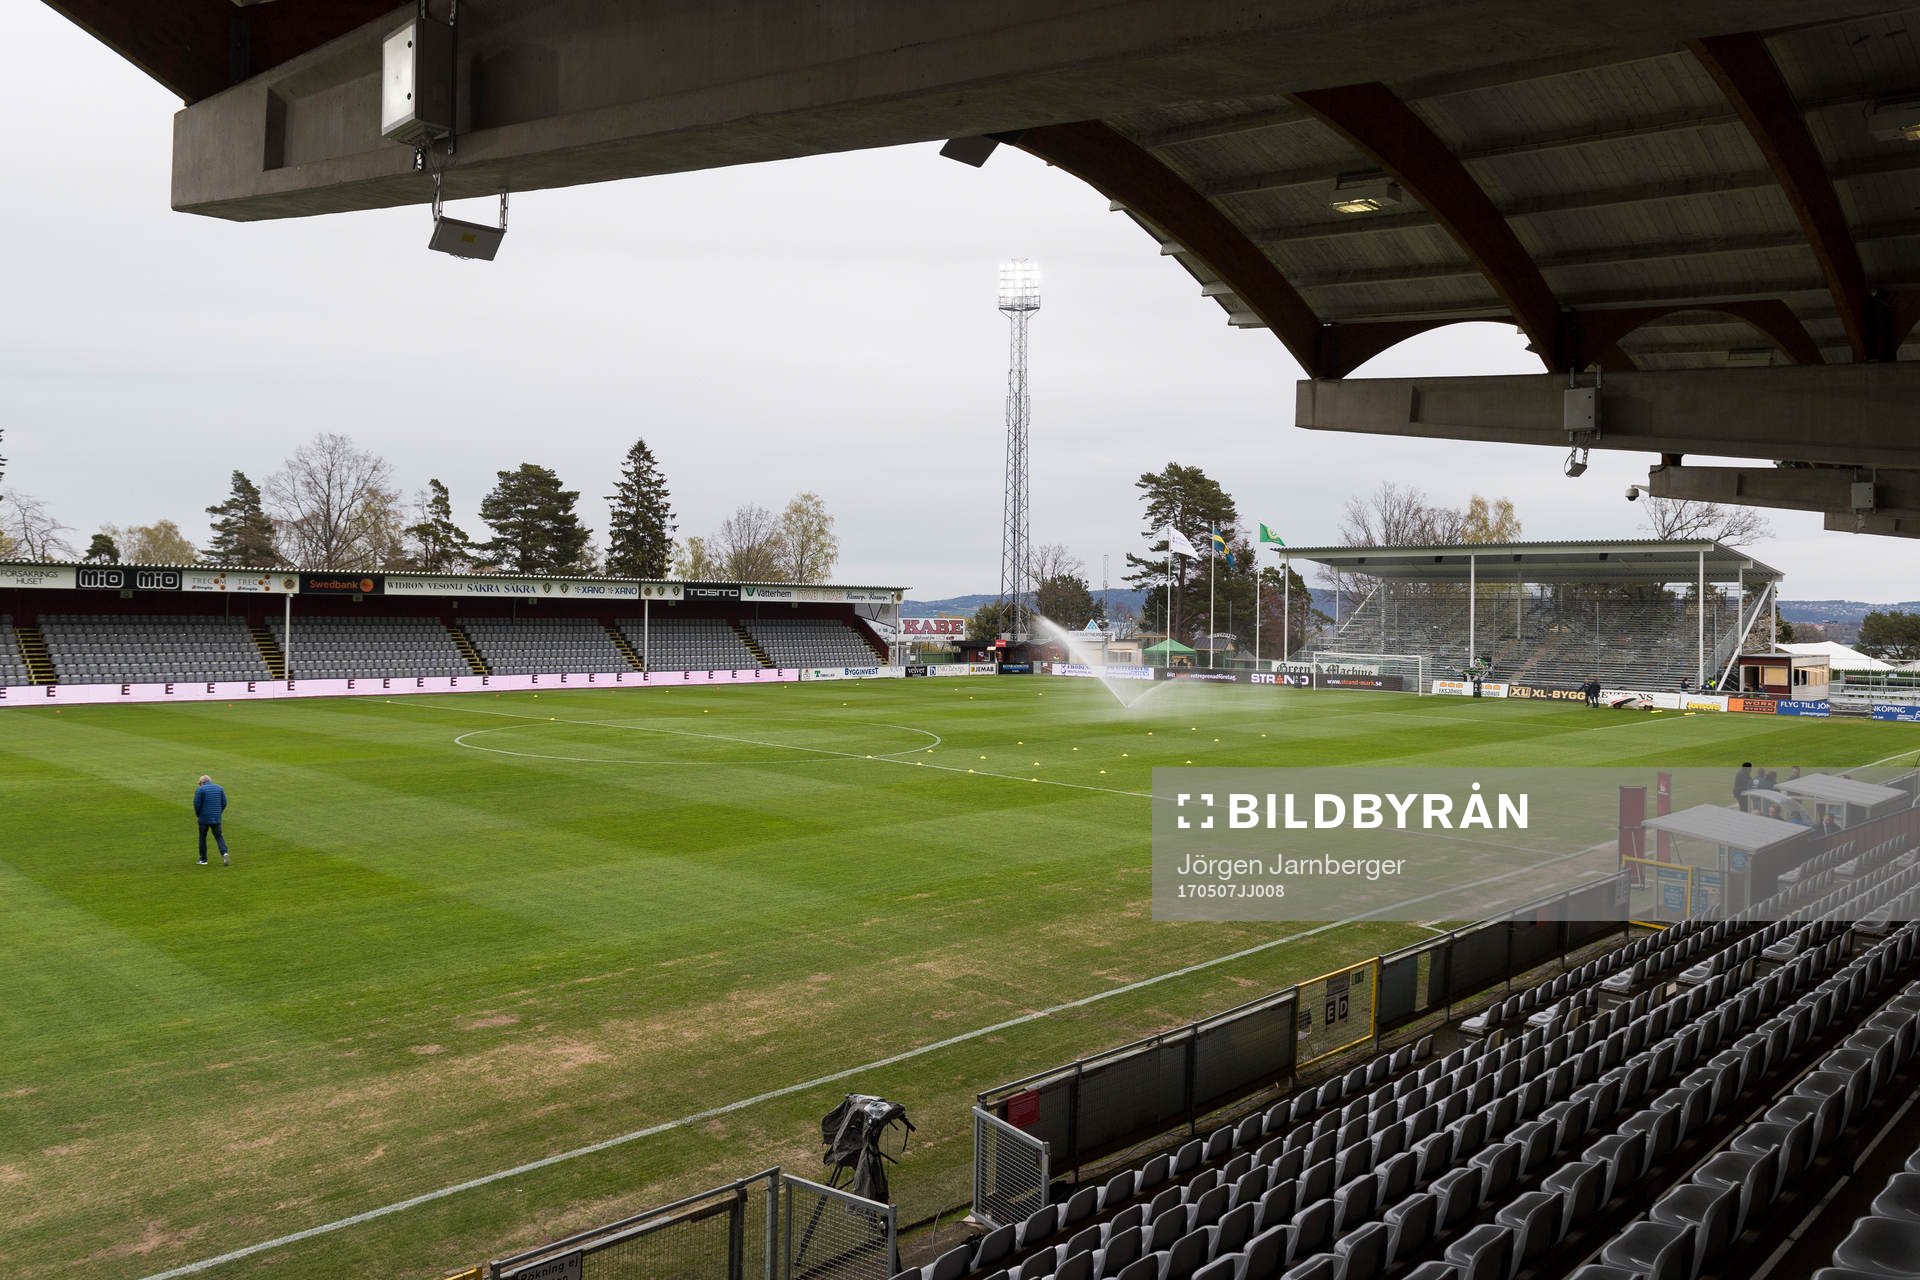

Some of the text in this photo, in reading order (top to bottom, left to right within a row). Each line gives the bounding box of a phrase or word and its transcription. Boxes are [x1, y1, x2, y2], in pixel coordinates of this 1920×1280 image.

[310, 580, 359, 589] Swedbank
[756, 588, 792, 597] Vätterhem
[903, 619, 964, 634] KABE
[47, 686, 56, 697] E
[121, 684, 131, 696] E
[165, 683, 174, 695] E
[207, 682, 215, 693] E
[248, 681, 256, 692] E
[287, 680, 295, 691] E
[347, 679, 355, 689] E
[383, 678, 390, 688] E
[417, 677, 424, 687] E
[1532, 688, 1586, 700] XL-BYGG
[1780, 701, 1798, 709] FLYG
